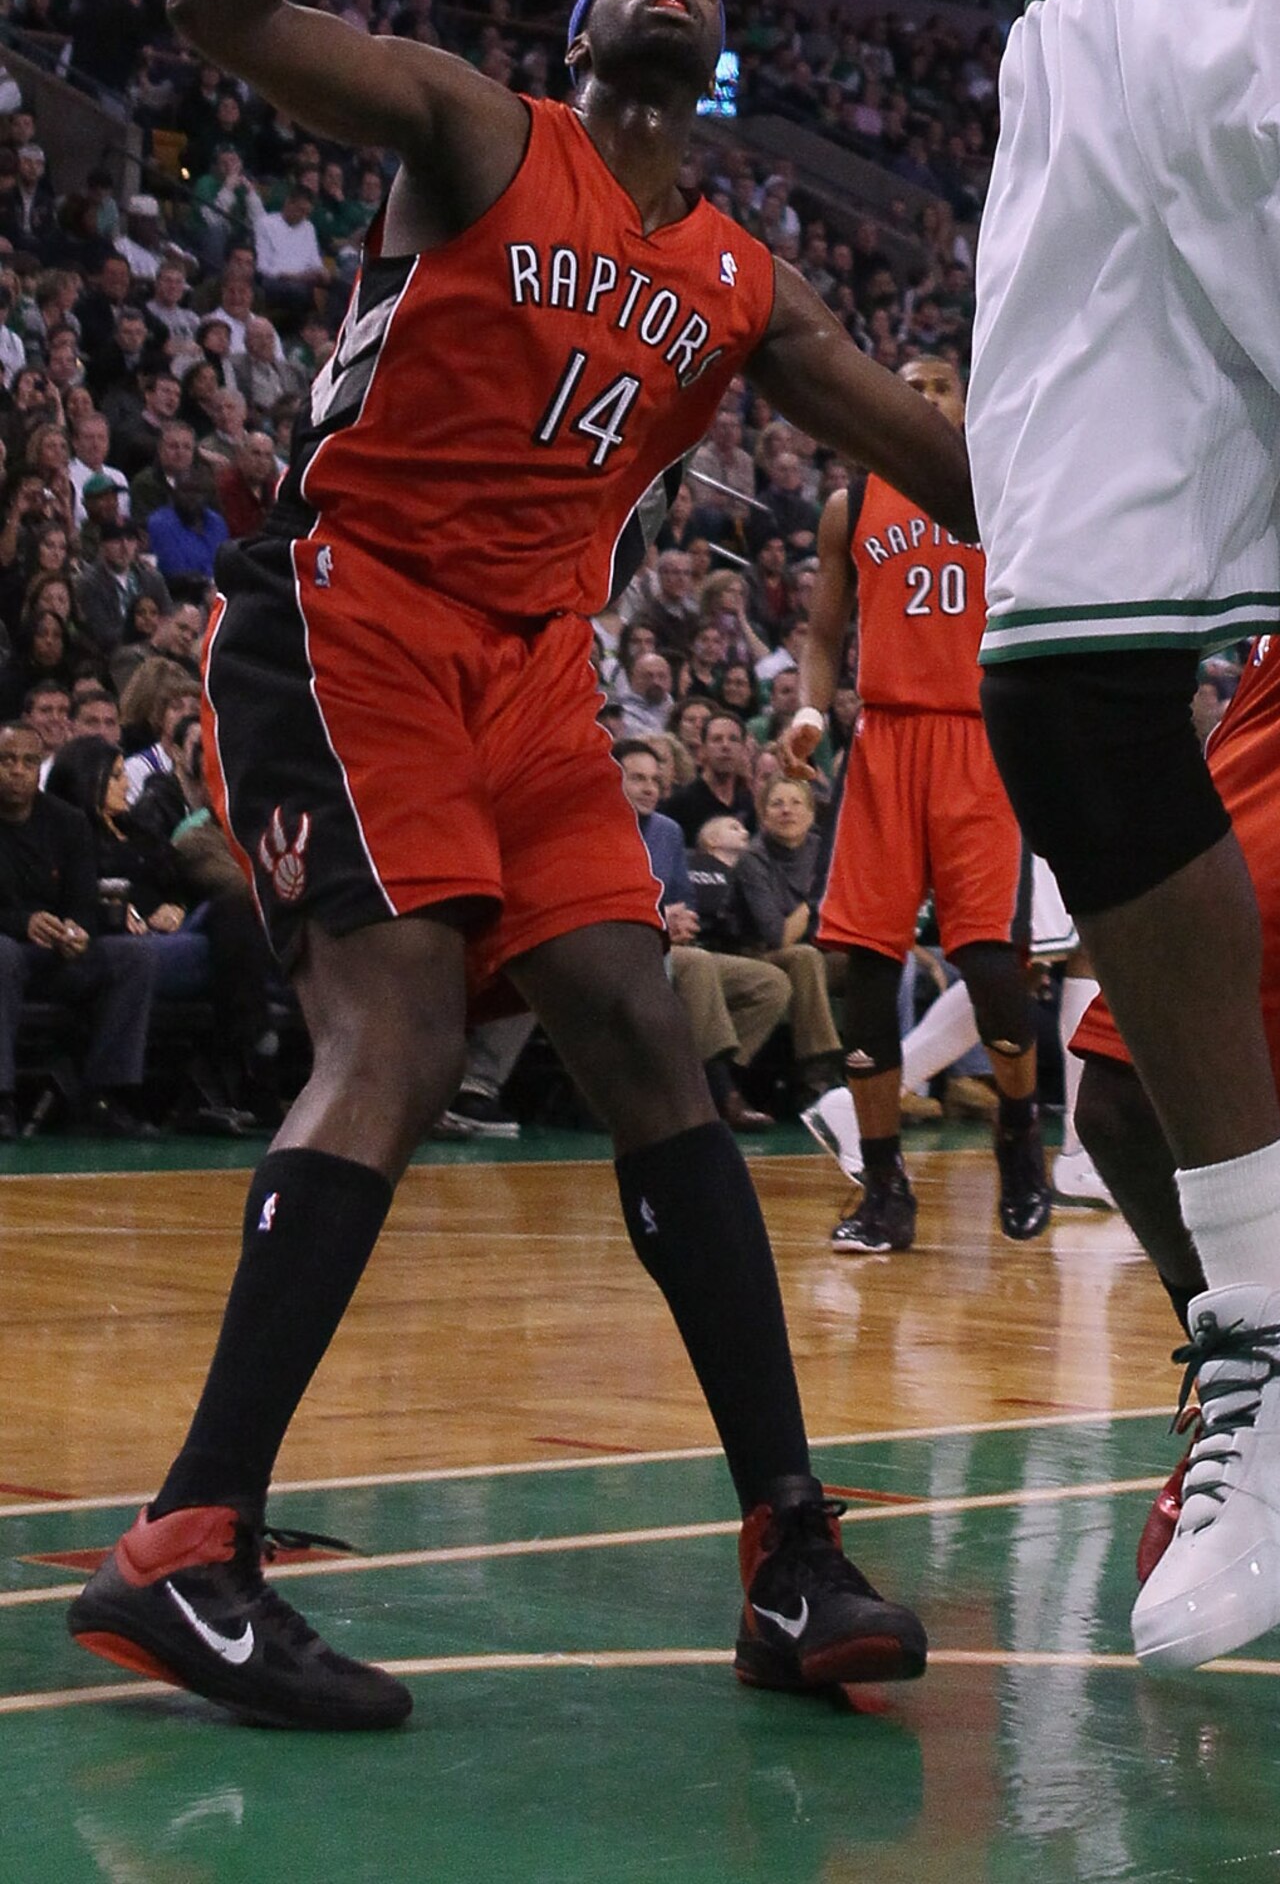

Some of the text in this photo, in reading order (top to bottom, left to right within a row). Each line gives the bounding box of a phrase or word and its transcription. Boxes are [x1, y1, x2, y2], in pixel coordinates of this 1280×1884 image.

[530, 346, 642, 470] 14
[863, 518, 982, 566] RAPT
[905, 563, 967, 616] 20
